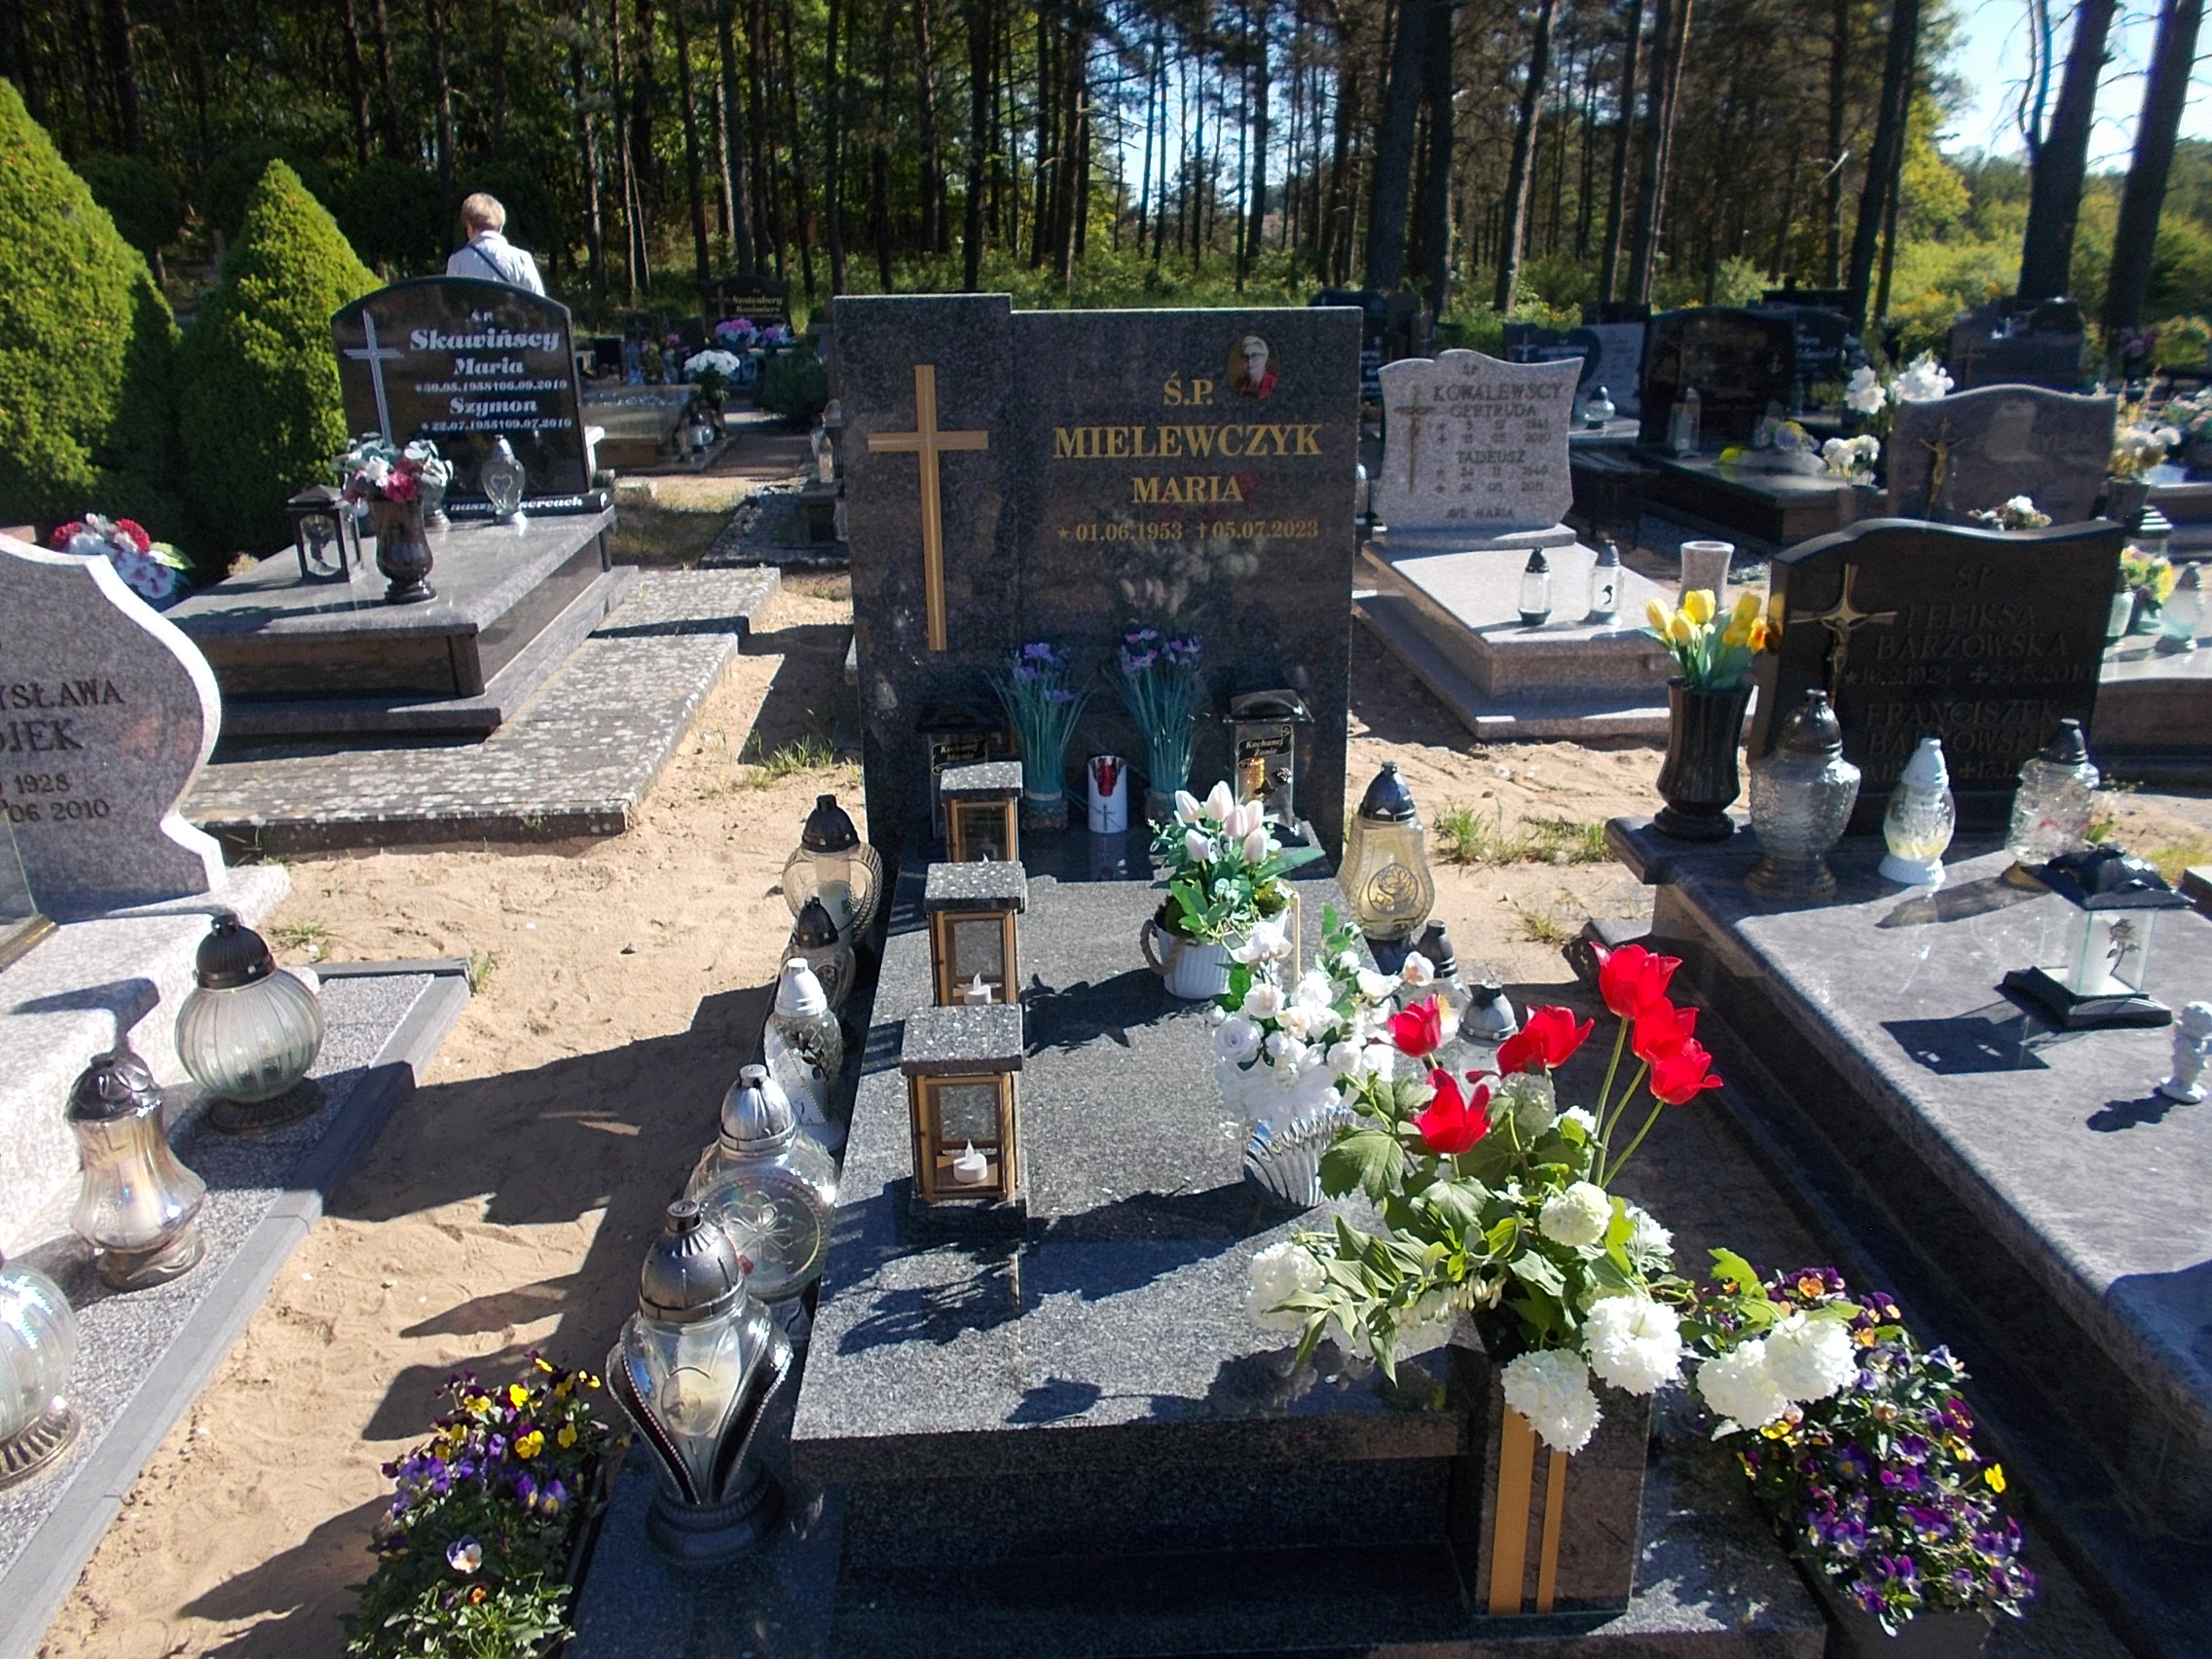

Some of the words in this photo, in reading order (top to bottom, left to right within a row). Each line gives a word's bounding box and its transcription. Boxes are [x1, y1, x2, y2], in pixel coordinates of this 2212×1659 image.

[409, 327, 560, 351] Skawińscy
[453, 356, 525, 376] Maria
[1162, 371, 1214, 406] Ś.P.
[1433, 383, 1564, 402] KOWALEWSCY
[449, 396, 538, 417] Szymon
[1450, 404, 1537, 418] GERTRUDA
[1051, 424, 1323, 460] MIELEWCZYK
[1456, 450, 1527, 464] TADEUSZ
[1131, 475, 1244, 504] MARIA
[1475, 506, 1516, 519] MARIA
[1075, 521, 1183, 542] 01.06.1953
[1212, 519, 1319, 539] 05.07.2023
[1905, 604, 2037, 630] FELIKSA
[1876, 631, 2070, 660] BARZOWSKA
[0, 719, 84, 754] JEK
[15, 772, 71, 794] 1928
[52, 797, 111, 822] 2010
